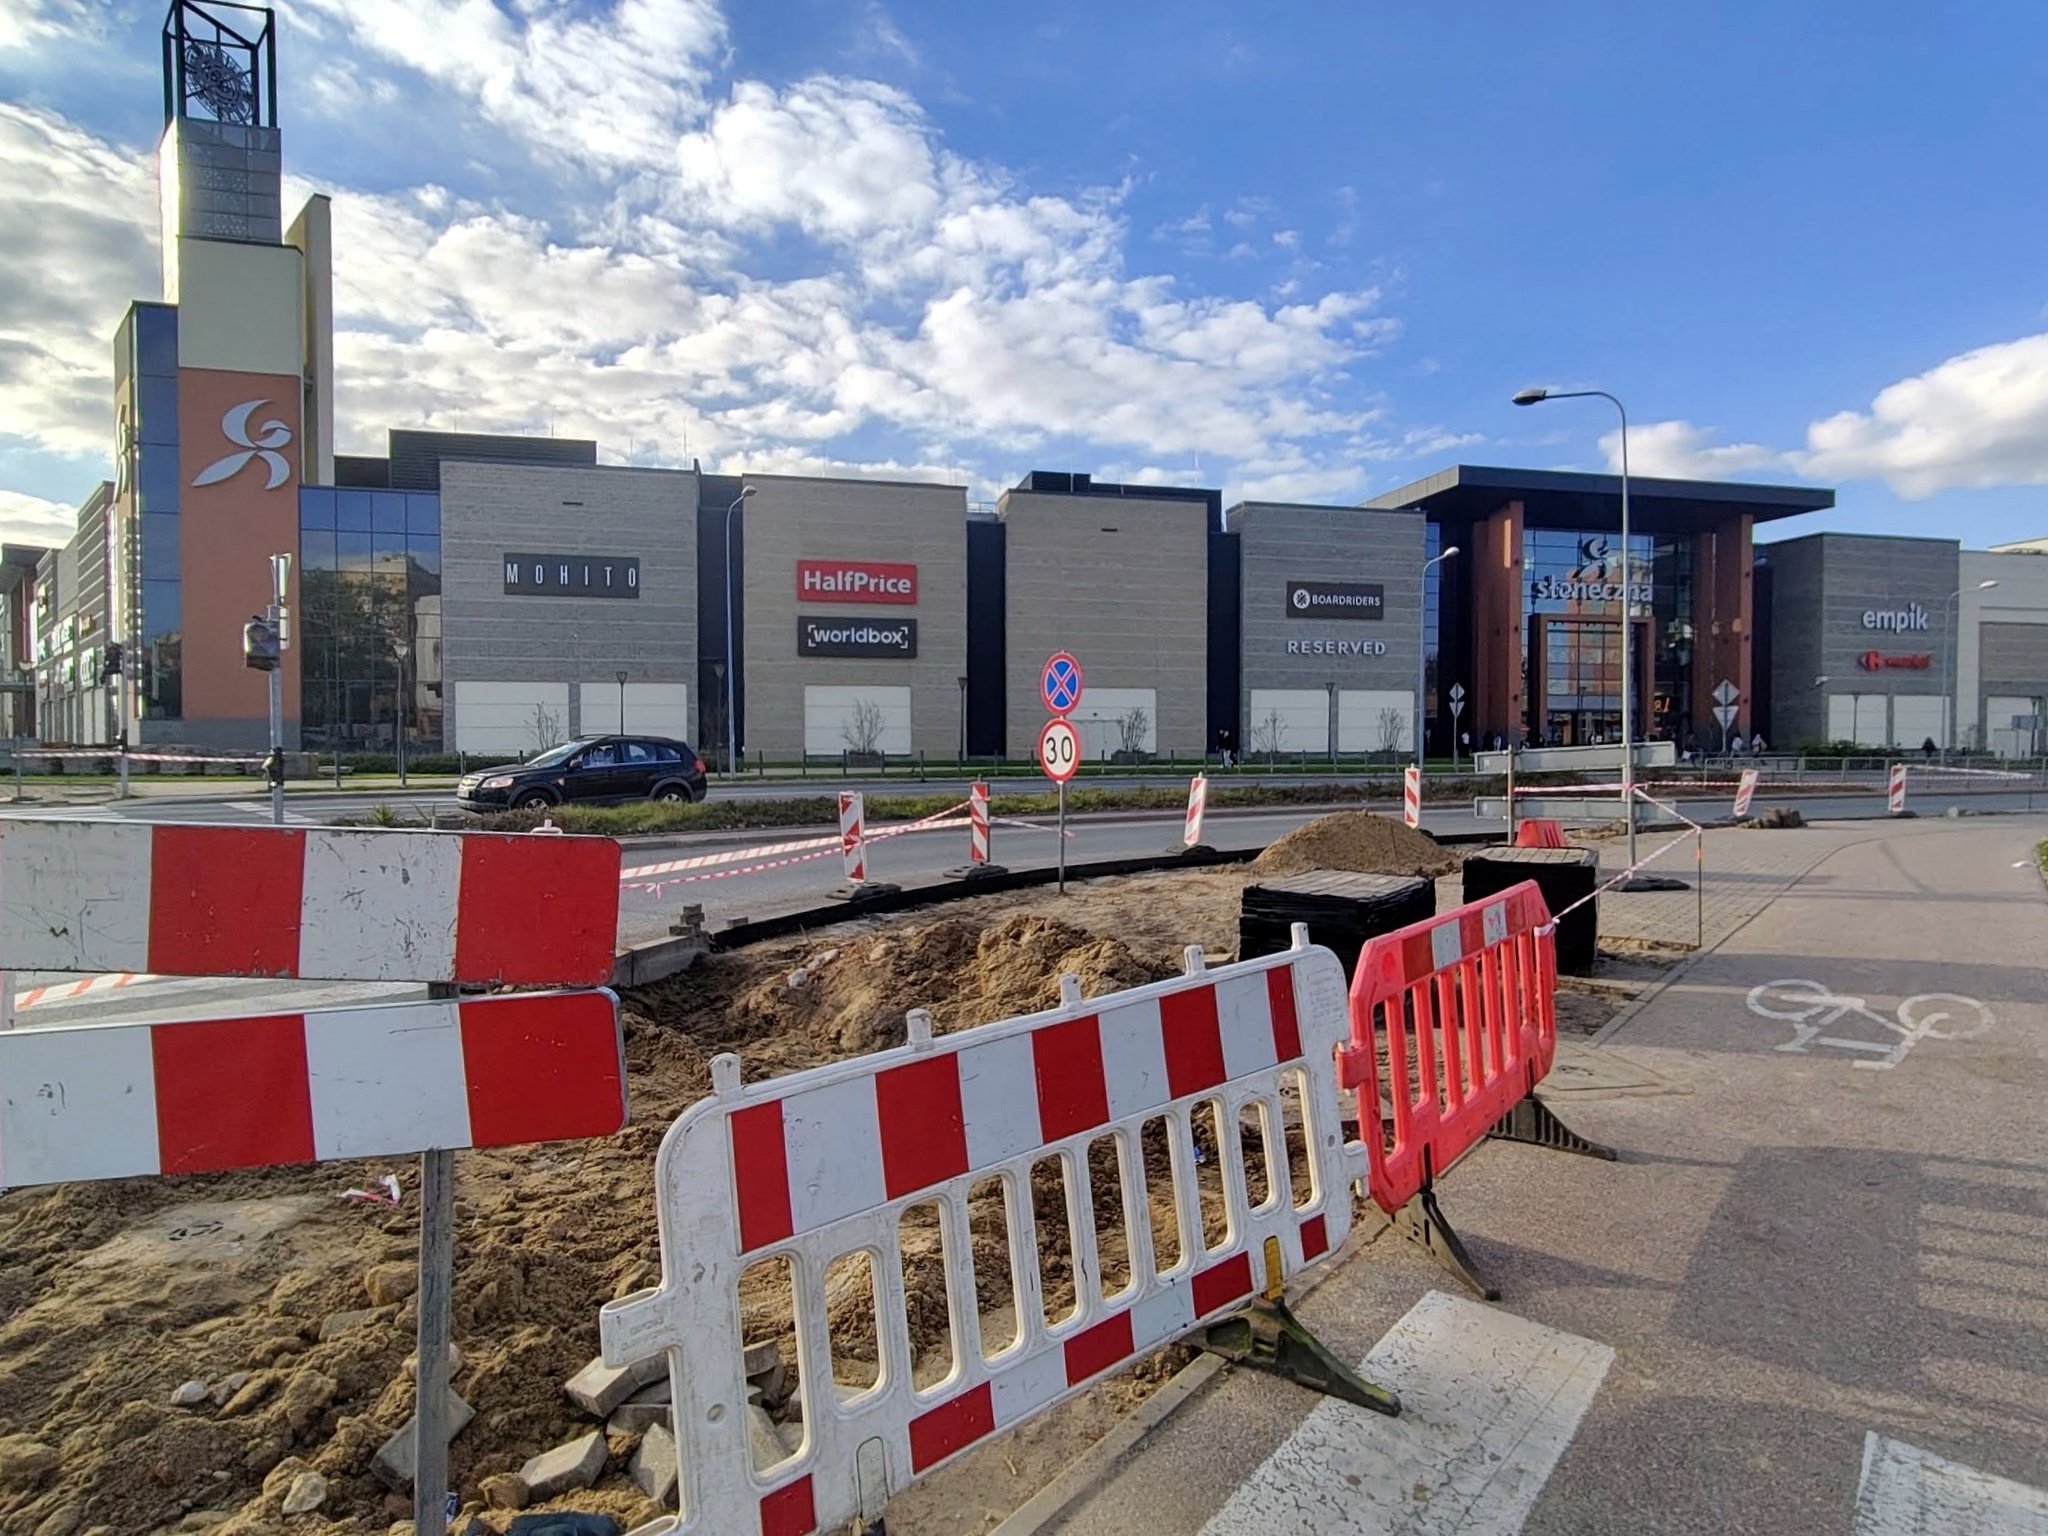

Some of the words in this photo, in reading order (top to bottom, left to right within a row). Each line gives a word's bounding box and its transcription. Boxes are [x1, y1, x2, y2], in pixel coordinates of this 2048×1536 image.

[506, 563, 636, 588] MOHITO
[804, 570, 912, 594] HalfPrice
[1312, 594, 1381, 607] BOARDRIDERS
[1862, 602, 1929, 634] empik
[1287, 640, 1387, 656] RESERVED
[1045, 735, 1074, 765] 30
